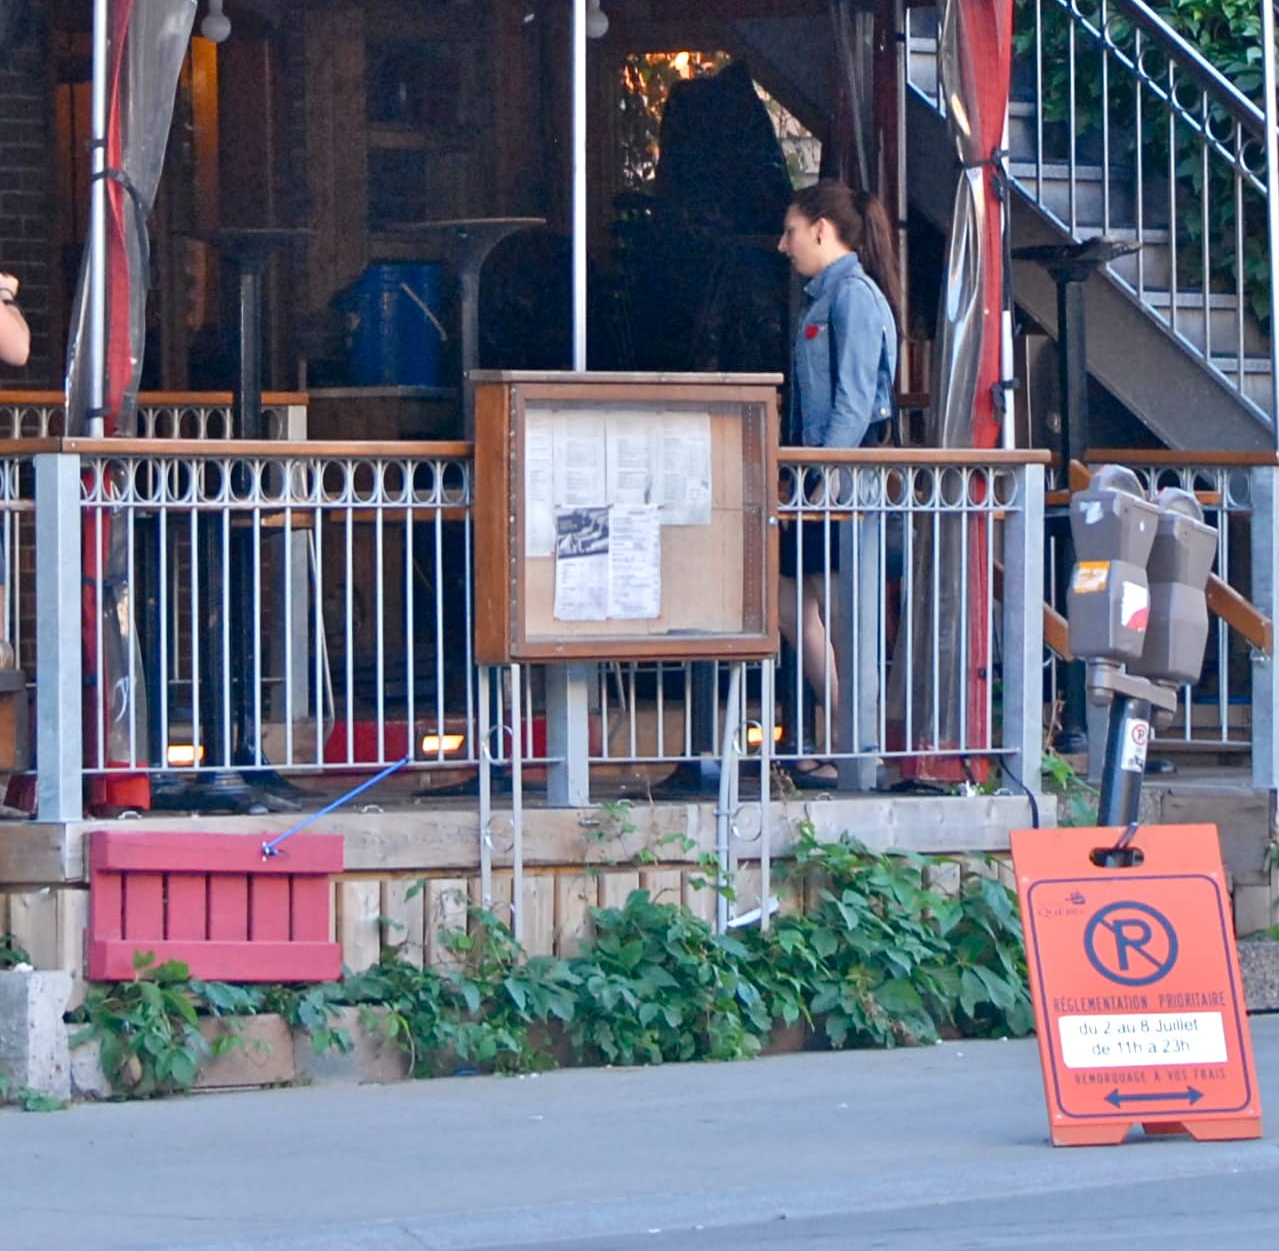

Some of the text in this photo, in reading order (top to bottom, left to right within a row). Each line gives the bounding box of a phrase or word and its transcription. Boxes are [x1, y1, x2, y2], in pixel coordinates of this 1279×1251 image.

[1159, 991, 1226, 1009] PRIORITAIRE
[1079, 1018, 1199, 1036] du 2 au 8 Juillet
[1091, 1043, 1111, 1056] de
[1117, 1040, 1143, 1054] 11h
[1162, 1039, 1190, 1054] 23h
[1167, 1068, 1188, 1081] VOS
[1192, 1067, 1226, 1080] FRAIS
